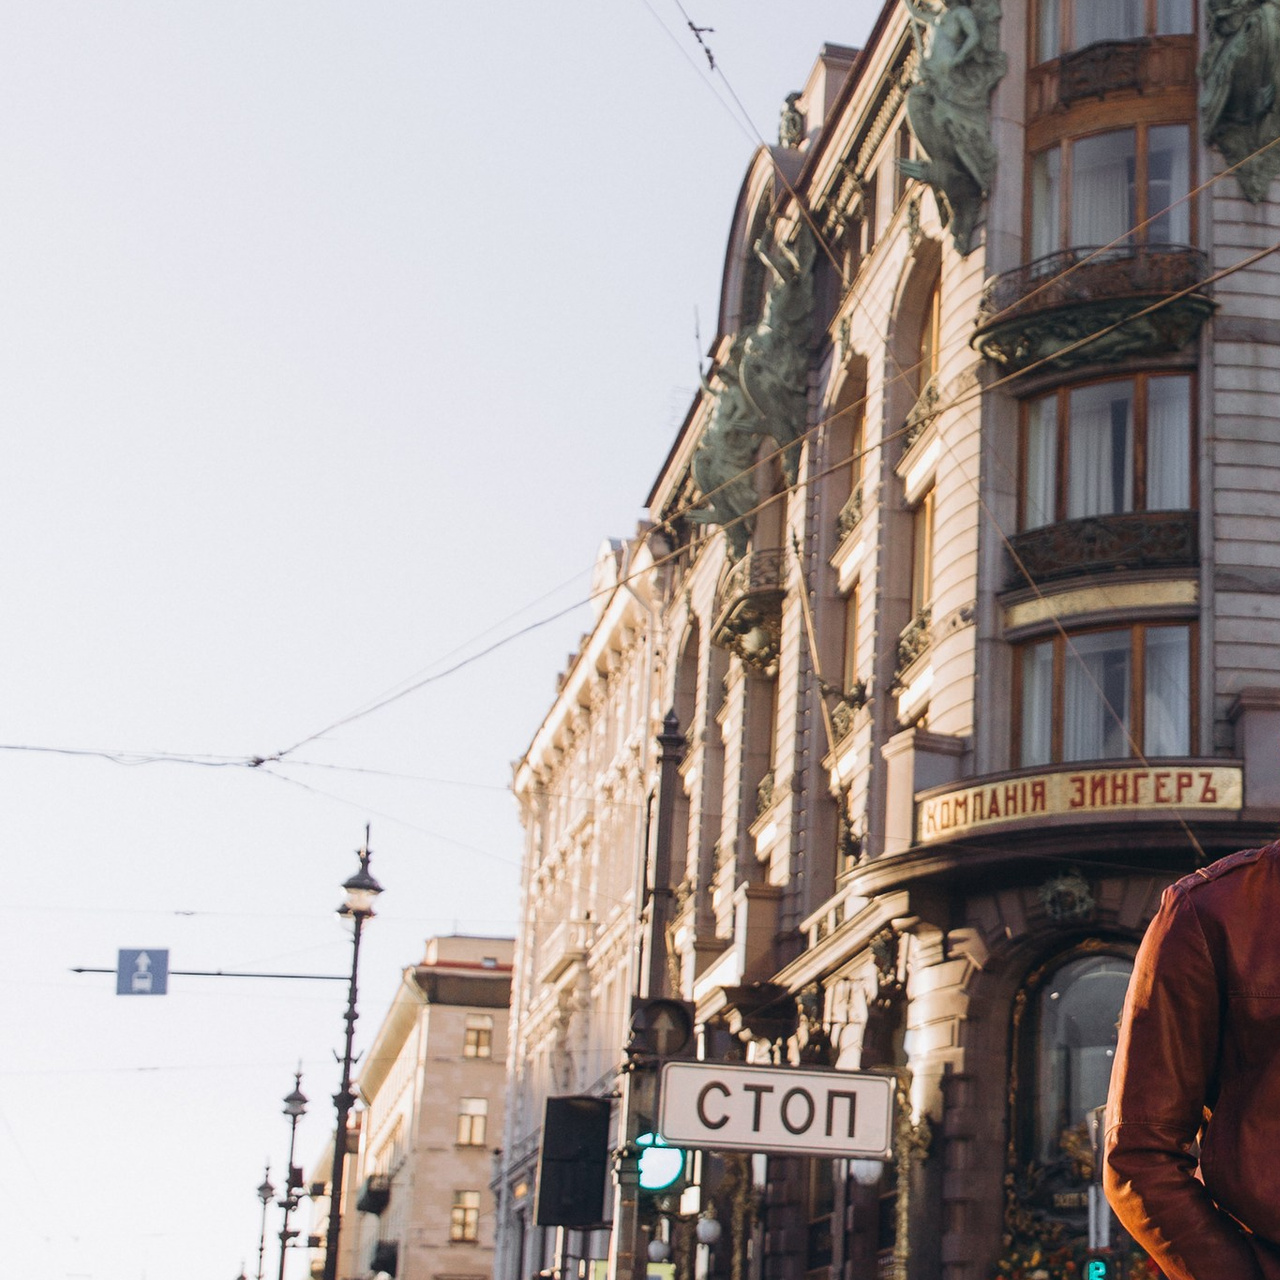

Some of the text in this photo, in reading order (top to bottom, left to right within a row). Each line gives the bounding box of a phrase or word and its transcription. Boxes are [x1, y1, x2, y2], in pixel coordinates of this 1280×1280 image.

[925, 772, 1217, 834] КОМПАНІЯ ЗИНГЕРЪ
[697, 1081, 857, 1138] СТОП
